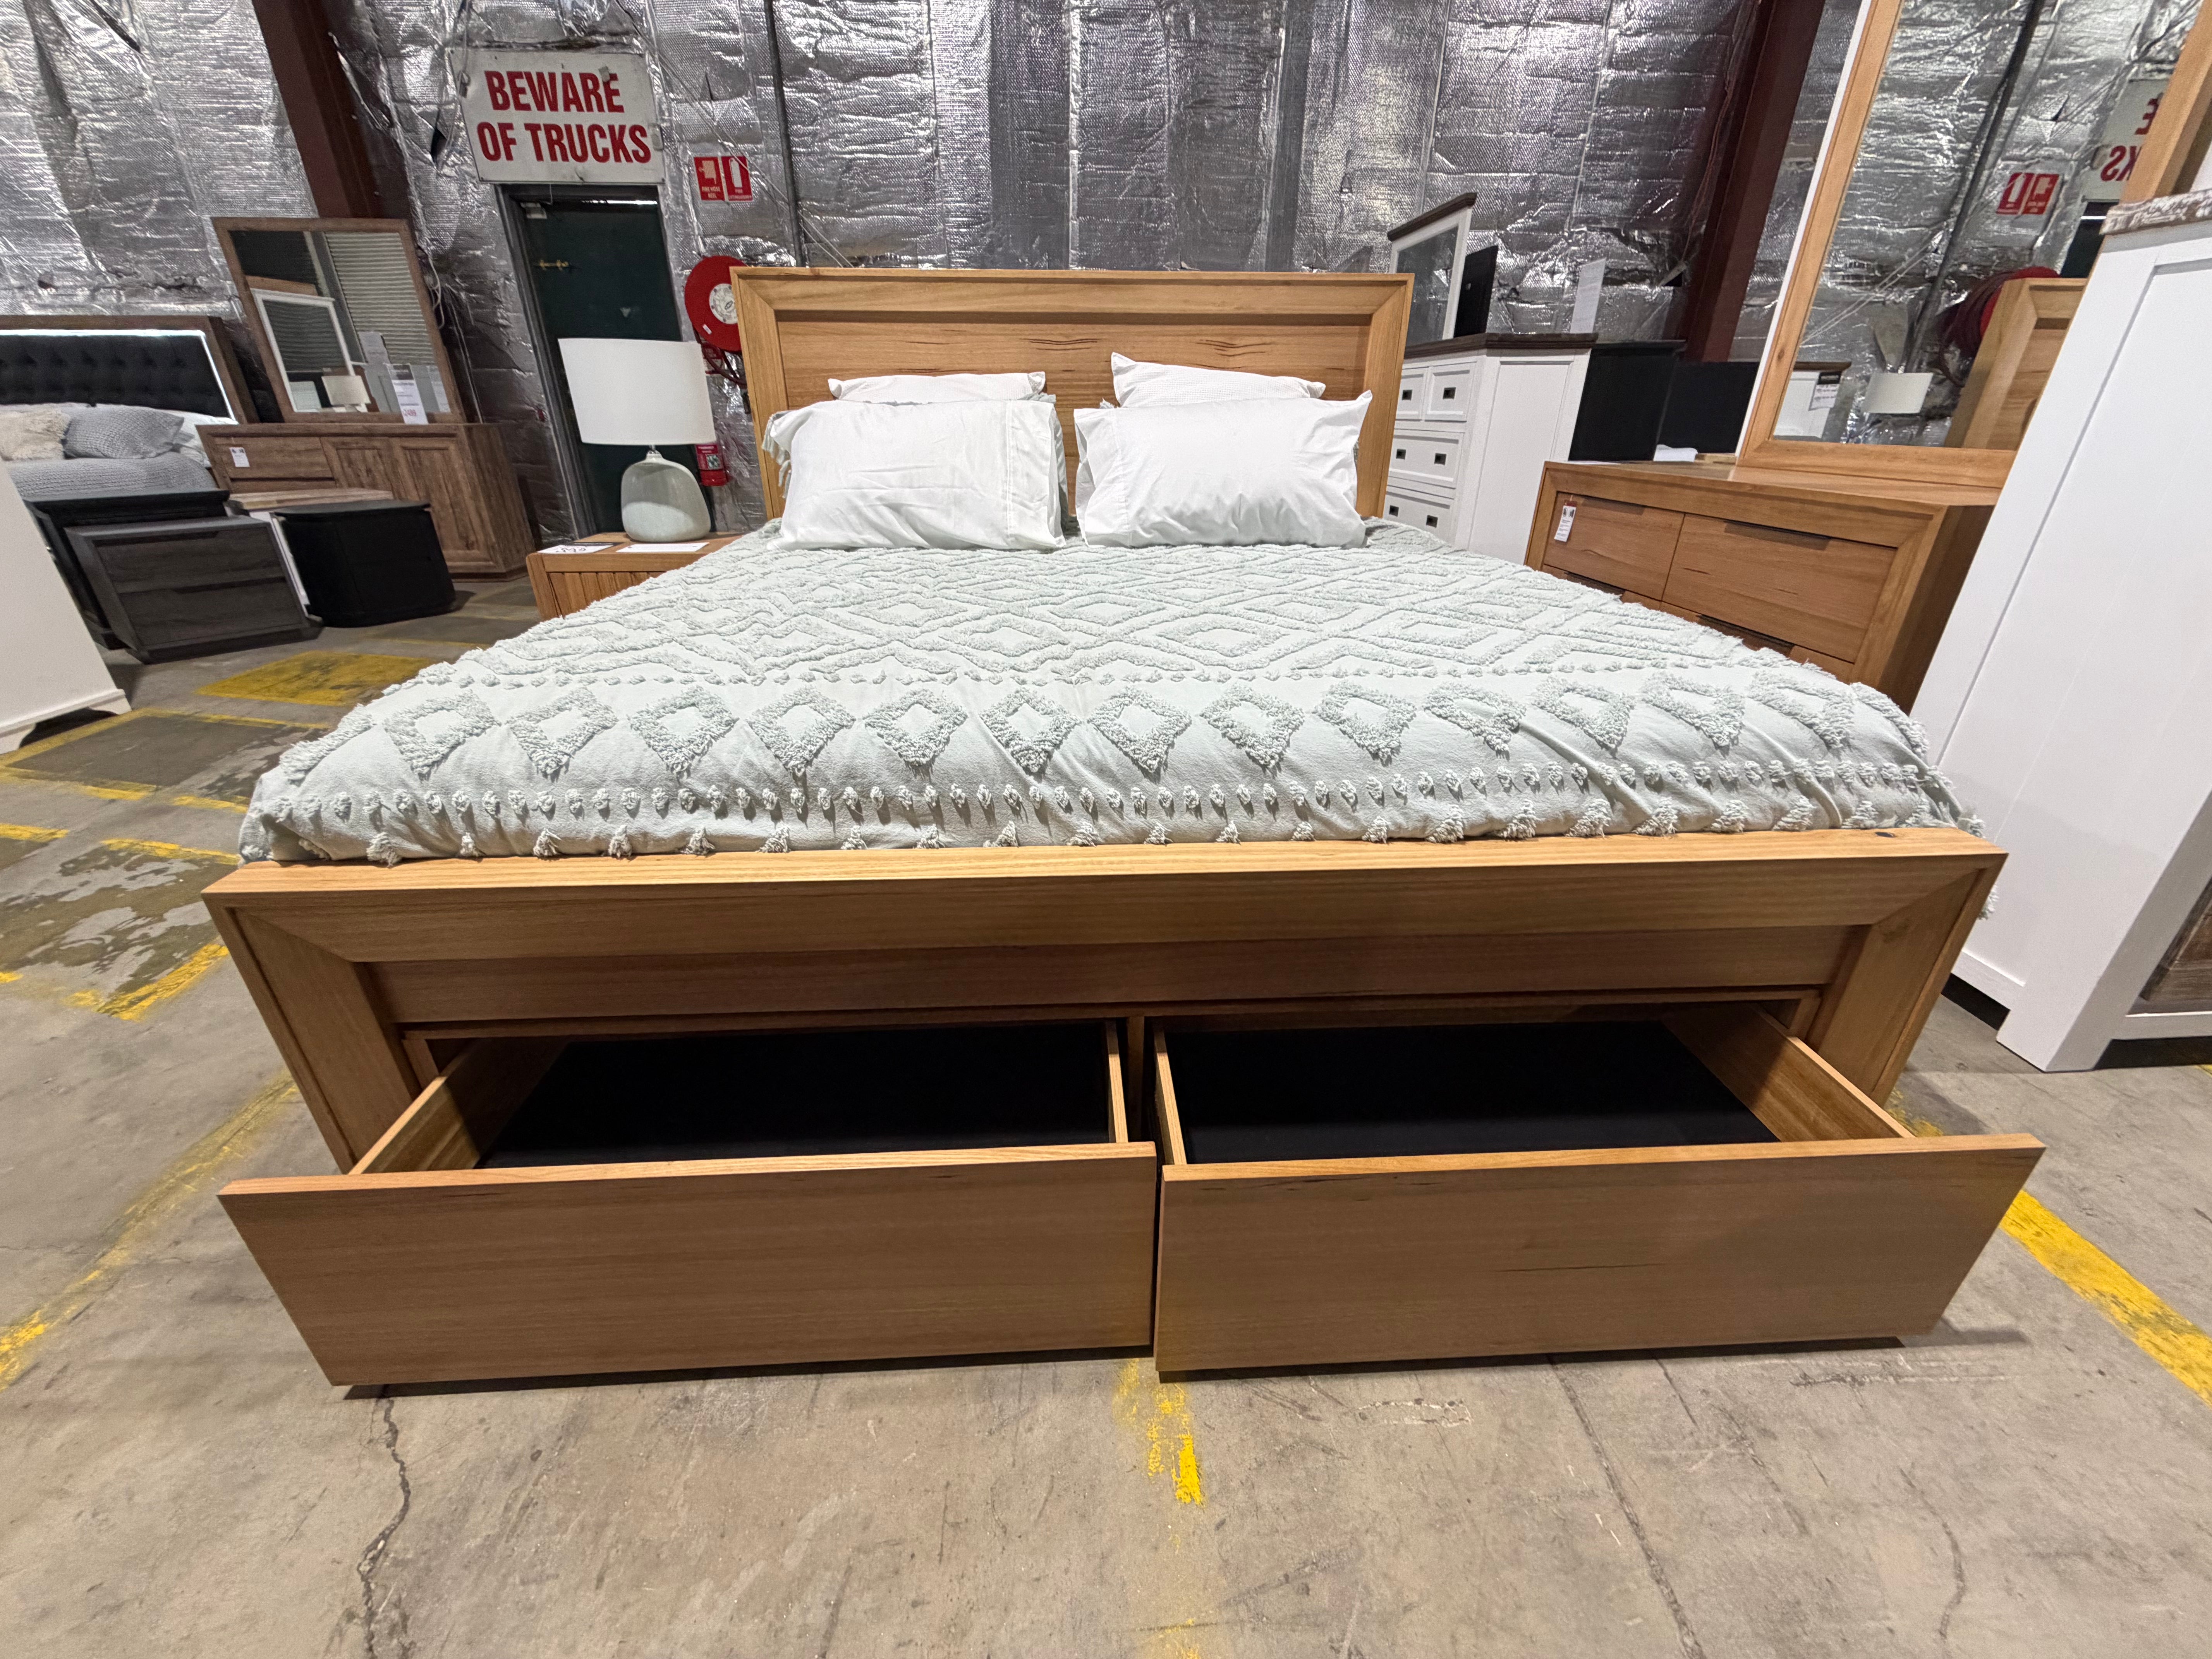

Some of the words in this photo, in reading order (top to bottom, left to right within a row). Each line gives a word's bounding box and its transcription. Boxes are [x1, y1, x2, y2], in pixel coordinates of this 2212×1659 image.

[485, 70, 625, 113] BEWARE
[477, 122, 517, 161] OF
[524, 123, 652, 164] TRUCKS
